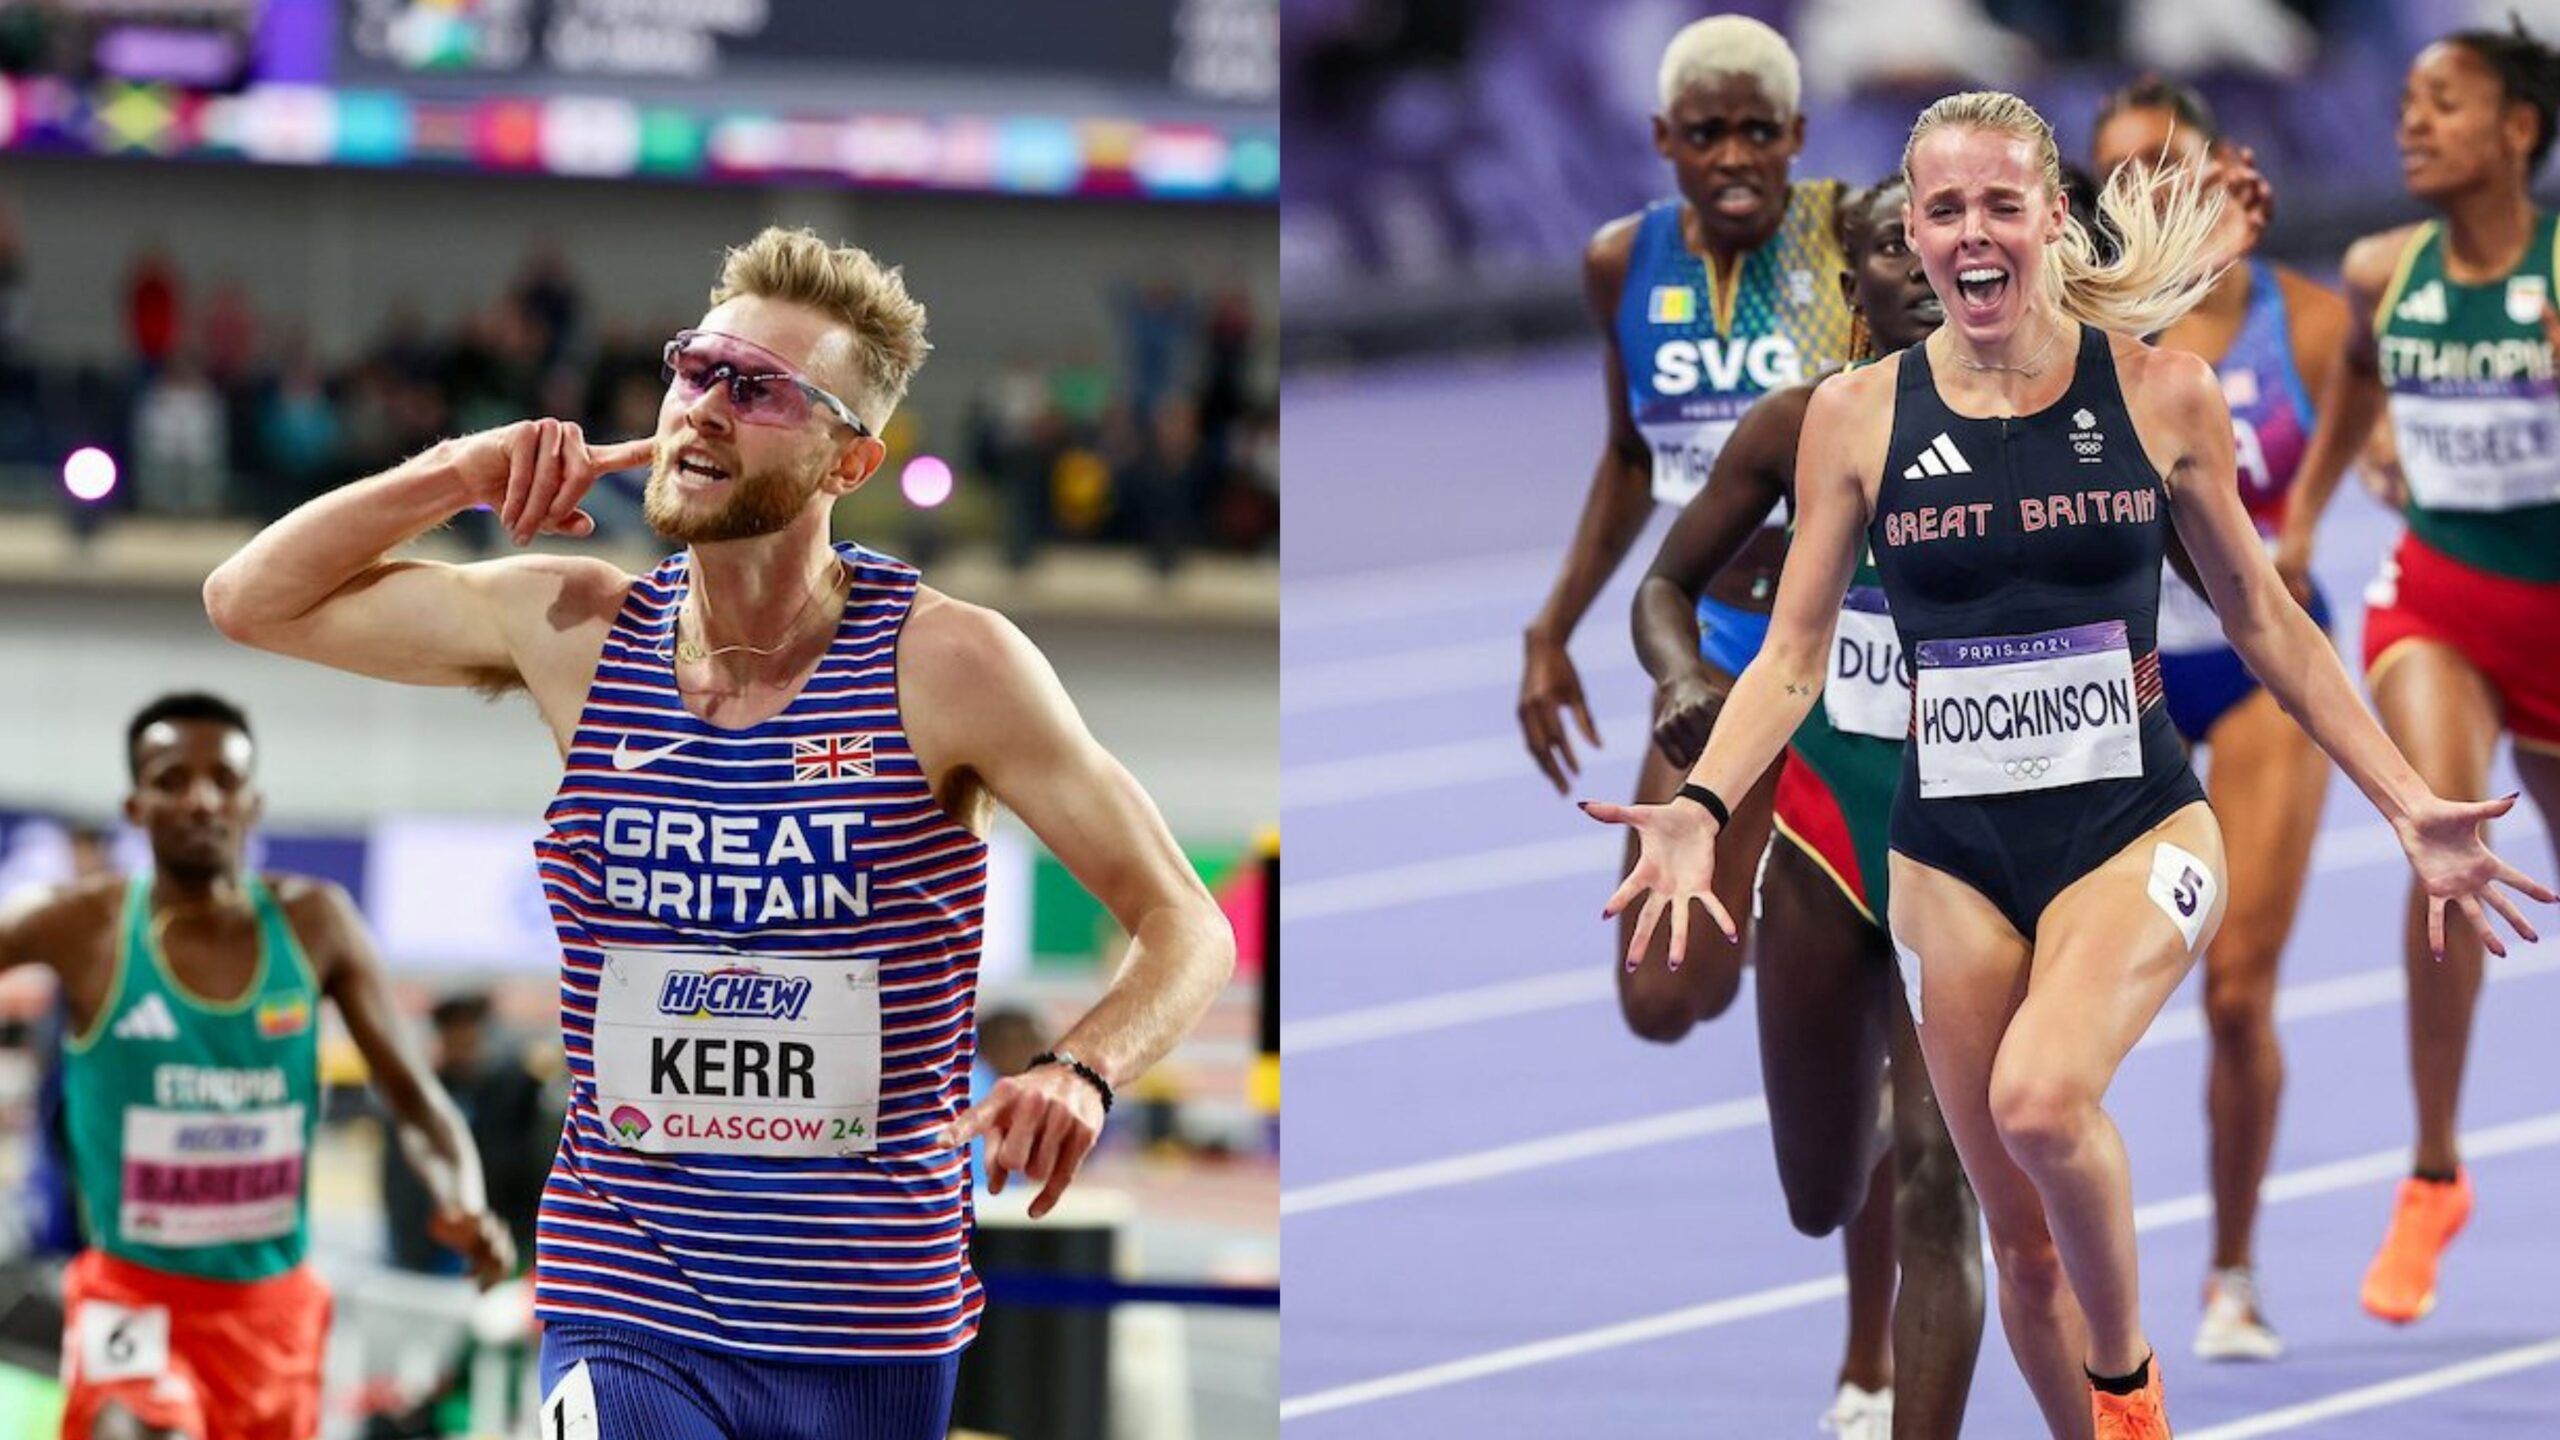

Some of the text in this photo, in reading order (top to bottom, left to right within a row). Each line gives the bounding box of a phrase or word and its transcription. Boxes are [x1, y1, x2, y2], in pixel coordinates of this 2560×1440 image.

[1652, 336, 1802, 395] SVG
[2379, 335, 2554, 386] ETHIOPI
[1885, 487, 2155, 547] GREAT BRITAIN
[1958, 637, 2070, 661] PARIS 2024
[1923, 677, 2131, 745] HODGKINSON
[603, 806, 866, 866] GREAT
[604, 865, 869, 924] BRITAIN
[2174, 866, 2203, 917] 5
[660, 970, 812, 1021] HI-CHEW
[650, 1036, 816, 1099] KERR
[663, 1114, 865, 1142] GLASGOW 24
[105, 1317, 134, 1363] 6
